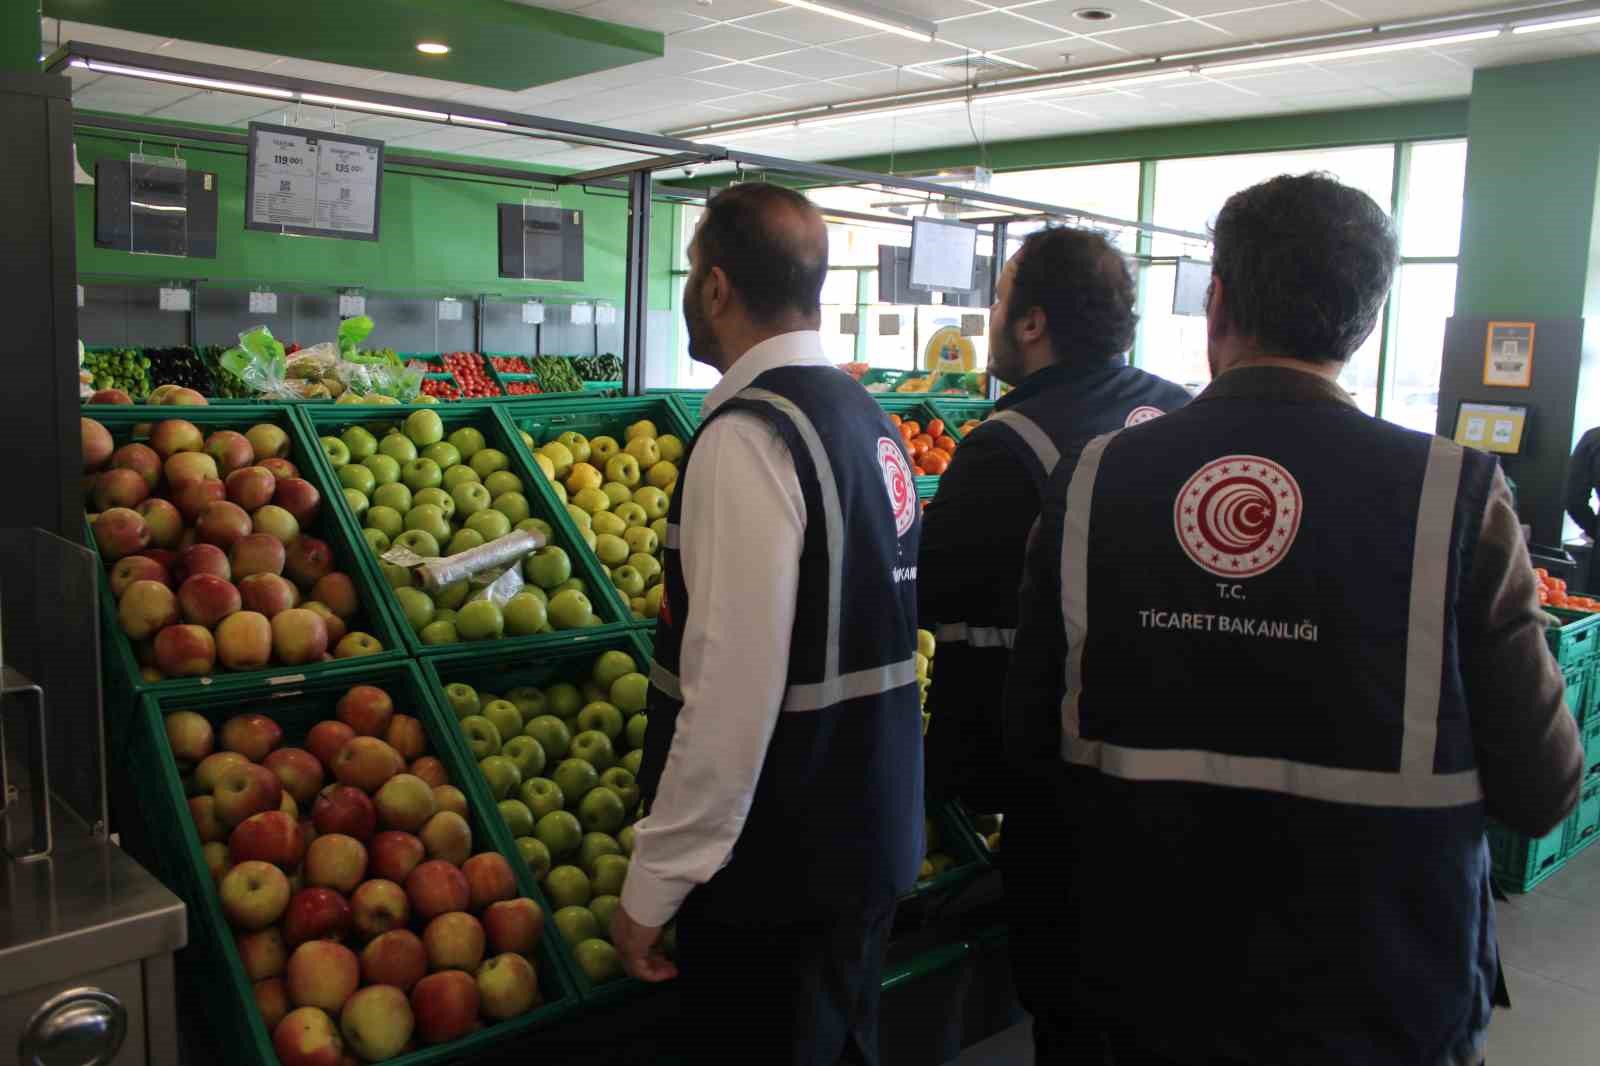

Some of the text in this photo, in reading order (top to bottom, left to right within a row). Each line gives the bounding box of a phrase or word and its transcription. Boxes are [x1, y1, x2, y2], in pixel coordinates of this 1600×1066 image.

[1216, 583, 1246, 600] T.C.
[1138, 609, 1318, 641] TİCARET BAKANLIĞI
